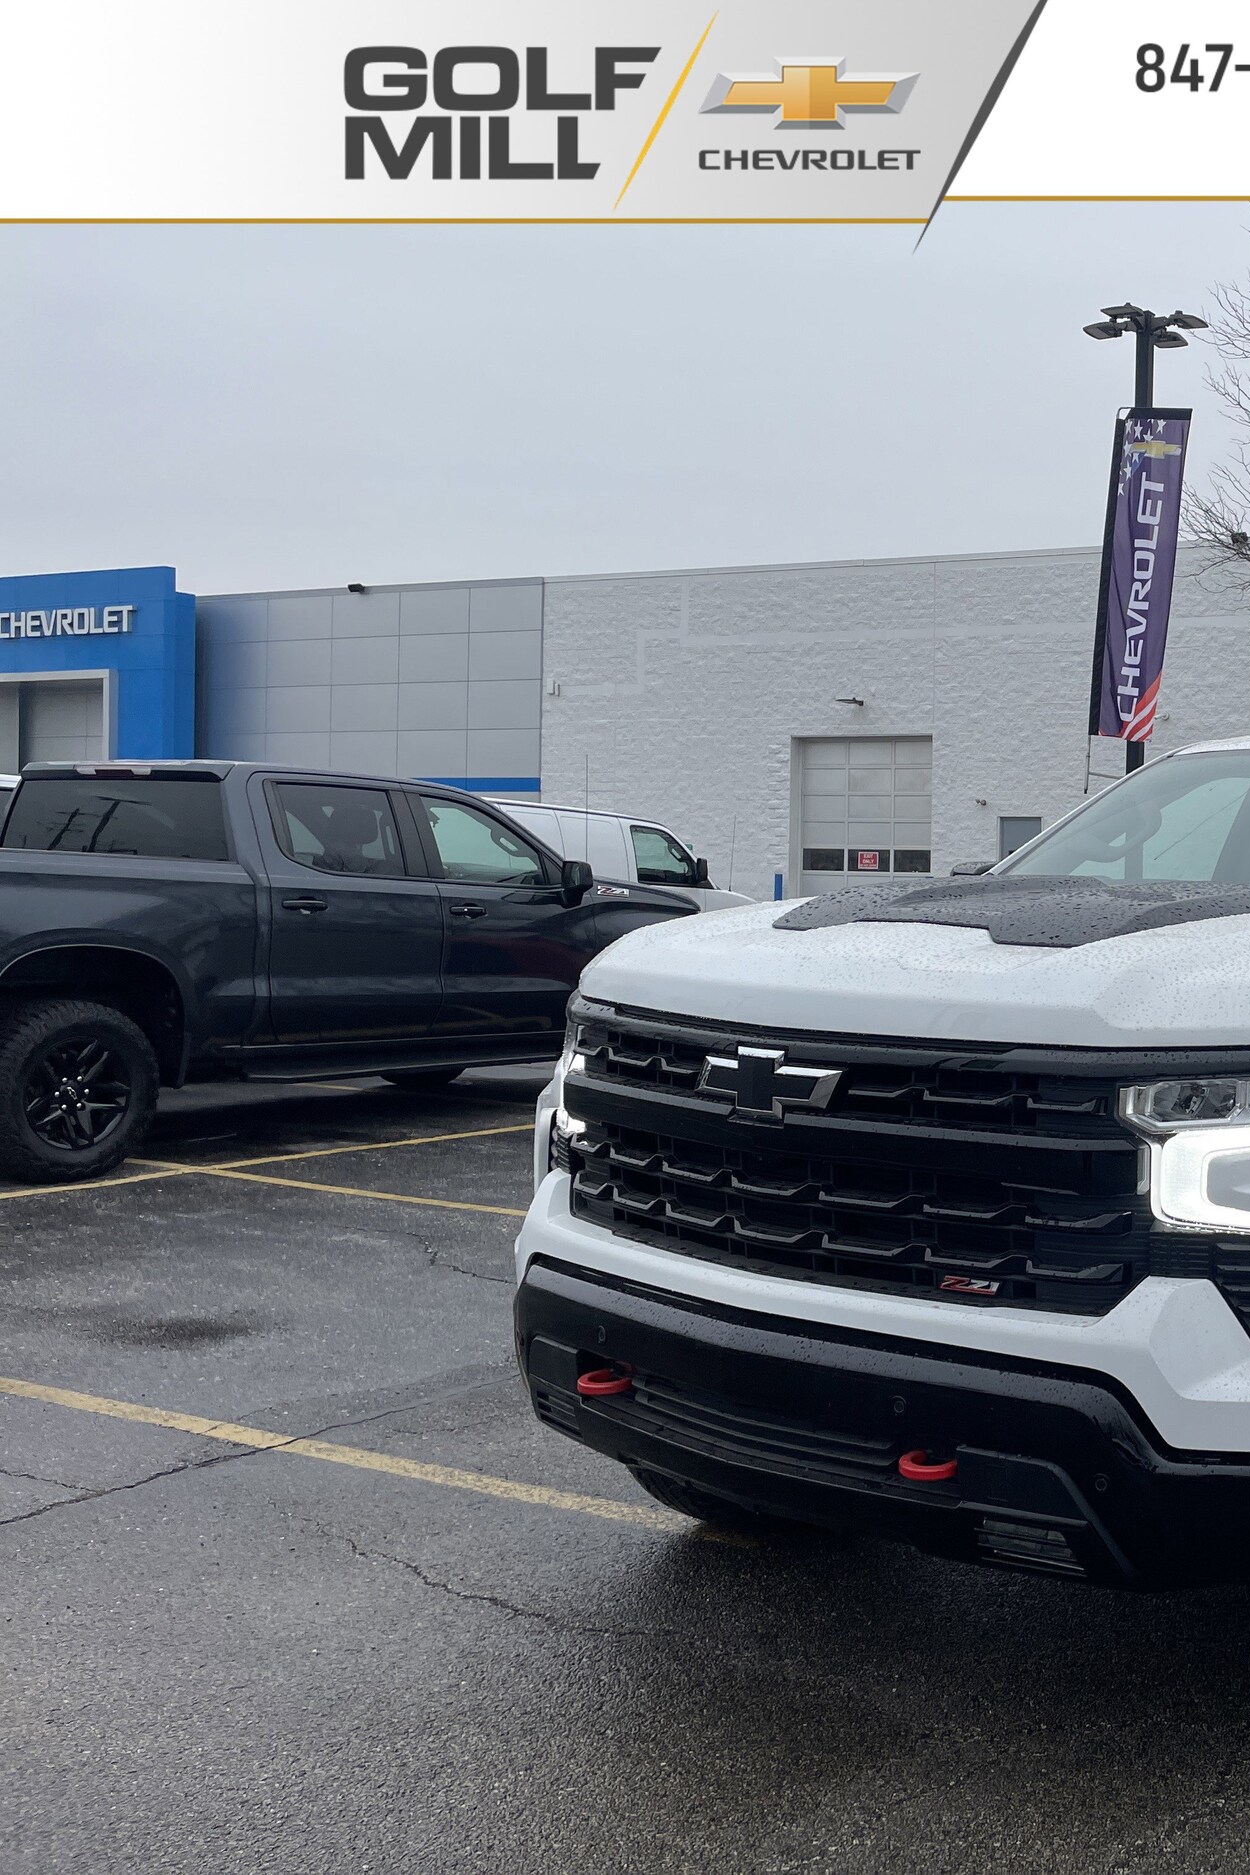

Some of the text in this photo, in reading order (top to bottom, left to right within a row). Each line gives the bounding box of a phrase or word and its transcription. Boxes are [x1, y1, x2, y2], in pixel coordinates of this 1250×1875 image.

[1117, 472, 1165, 722] CHEVROLET
[0, 605, 133, 638] CHEVROLET
[940, 1275, 1000, 1296] Z71
